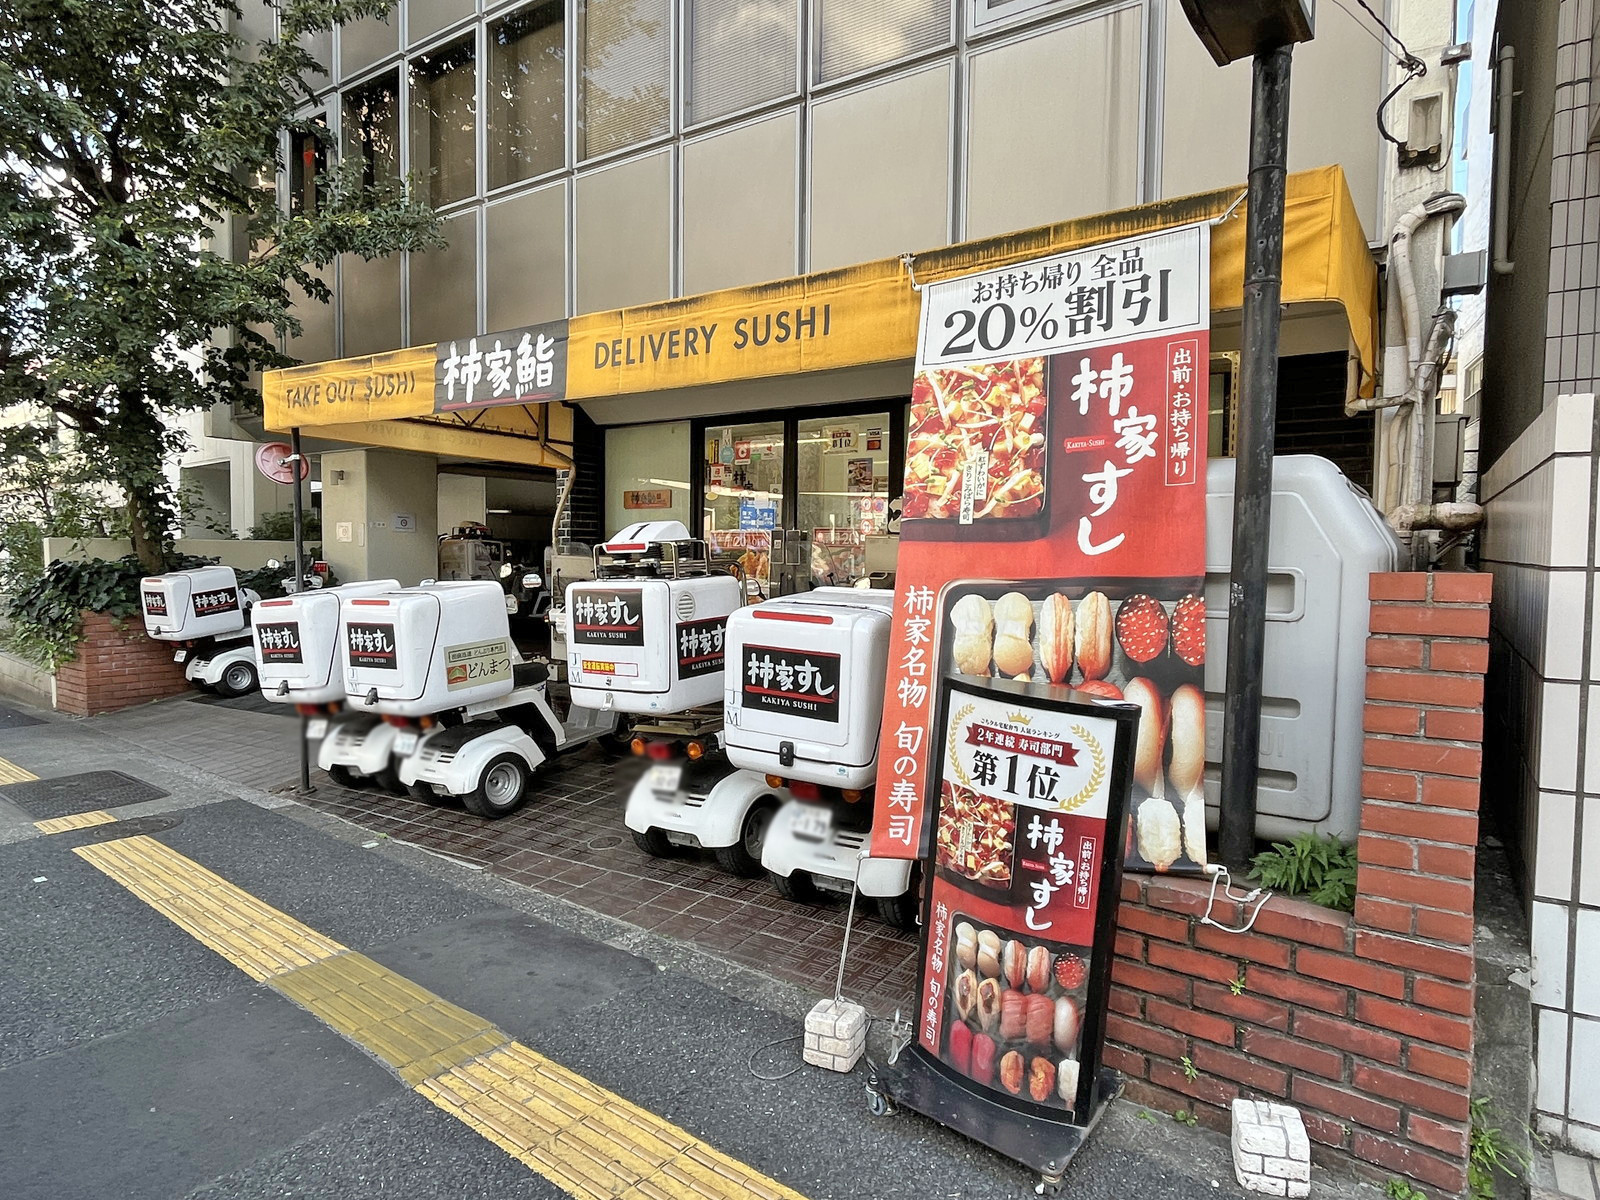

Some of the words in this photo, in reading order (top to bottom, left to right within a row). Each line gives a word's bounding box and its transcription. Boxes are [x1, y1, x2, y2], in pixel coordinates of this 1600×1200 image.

[972, 261, 1081, 304] お持ち帰り
[1091, 246, 1144, 281] 全品
[594, 323, 717, 370] DELIVERY
[733, 303, 830, 349] SUSHI
[940, 269, 1172, 356] 20%割引
[286, 384, 321, 409] TAKE
[326, 379, 357, 404] OUT
[363, 370, 415, 400] SUSHI
[442, 332, 555, 403] 柿家鮨
[1170, 347, 1193, 477] 出前・お持ち帰り
[1070, 352, 1158, 556] 柿家すし
[195, 591, 236, 608] 柿家すし
[575, 595, 640, 625] 柿家すし
[261, 627, 298, 649] 柿家すし
[350, 627, 394, 652] 柿家すし
[897, 584, 935, 709] 柿家名物
[468, 658, 510, 679] どんまつ
[747, 652, 835, 696] 柿家すし
[761, 695, 791, 706] KAKIYA
[792, 700, 817, 711] SUSHI
[977, 727, 1016, 749] 2年連続
[1018, 738, 1064, 758] 寿司部門
[1020, 727, 1060, 739] 人気ランキング
[887, 720, 924, 847] 旬の寿司
[970, 749, 1060, 803] 第1位
[1026, 814, 1075, 931] 柿家すし
[931, 901, 948, 974] 柿家名物
[925, 977, 940, 1047] 旬の寿司
